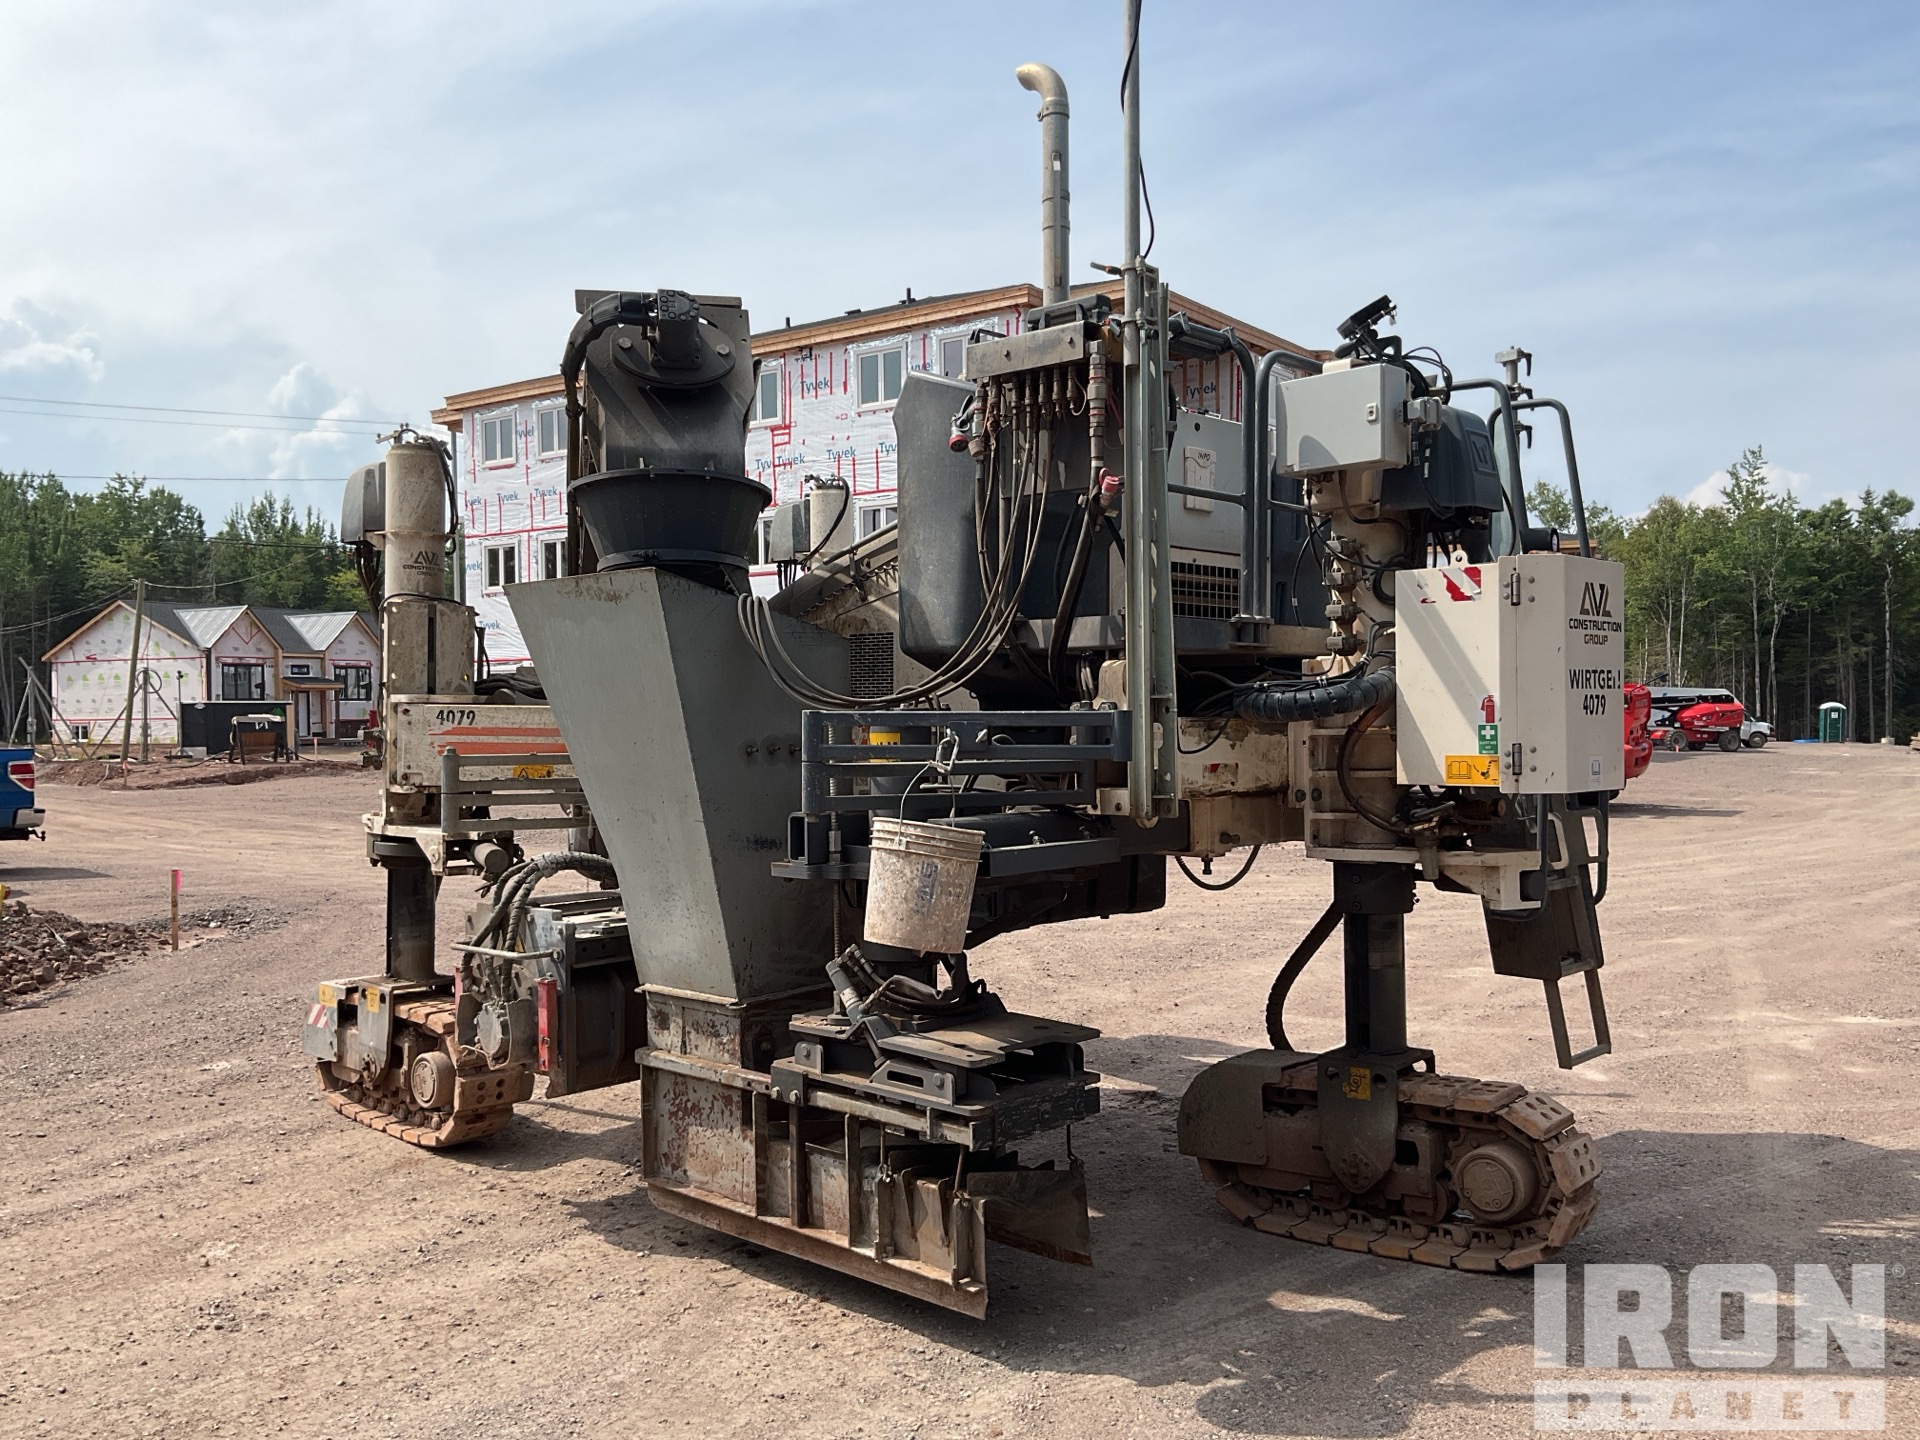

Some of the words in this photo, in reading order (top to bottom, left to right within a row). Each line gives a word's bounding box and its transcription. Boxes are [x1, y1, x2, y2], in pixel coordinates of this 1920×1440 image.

[800, 377, 830, 394] Tyvek
[826, 446, 856, 462] Tyvek
[879, 442, 897, 456] Tyv
[776, 453, 805, 470] Tyvek
[497, 491, 519, 505] Tyvek
[534, 486, 557, 498] Tyvek
[1568, 618, 1622, 633] CONSTRUCTION
[1584, 633, 1609, 646] GROUP
[1582, 693, 1606, 716] 4079
[435, 709, 476, 726] 4079
